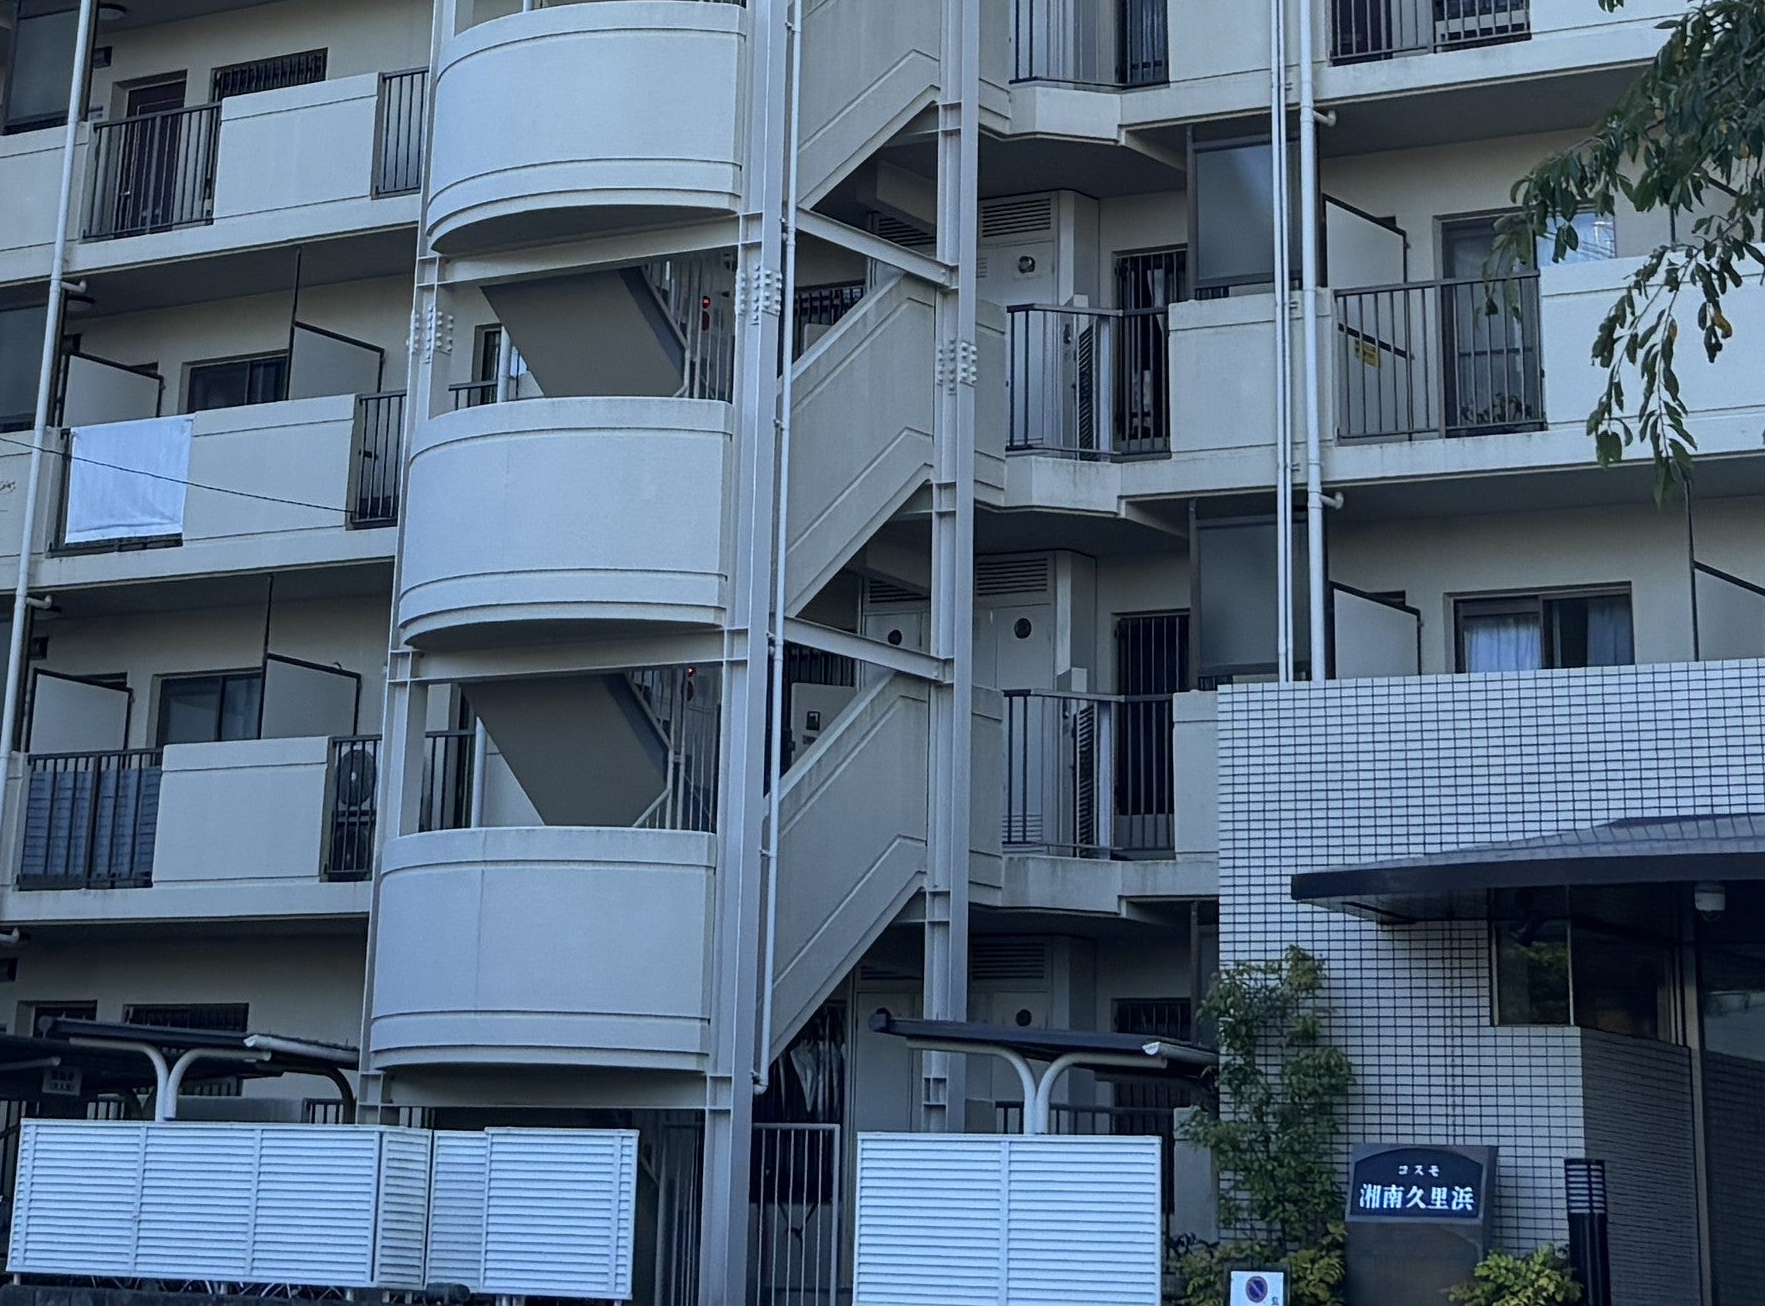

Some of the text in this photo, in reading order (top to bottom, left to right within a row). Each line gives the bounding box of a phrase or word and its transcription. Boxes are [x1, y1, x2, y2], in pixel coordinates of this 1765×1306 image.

[1398, 1165, 1440, 1177] コスモ
[1359, 1183, 1475, 1211] 湘南久里浜
